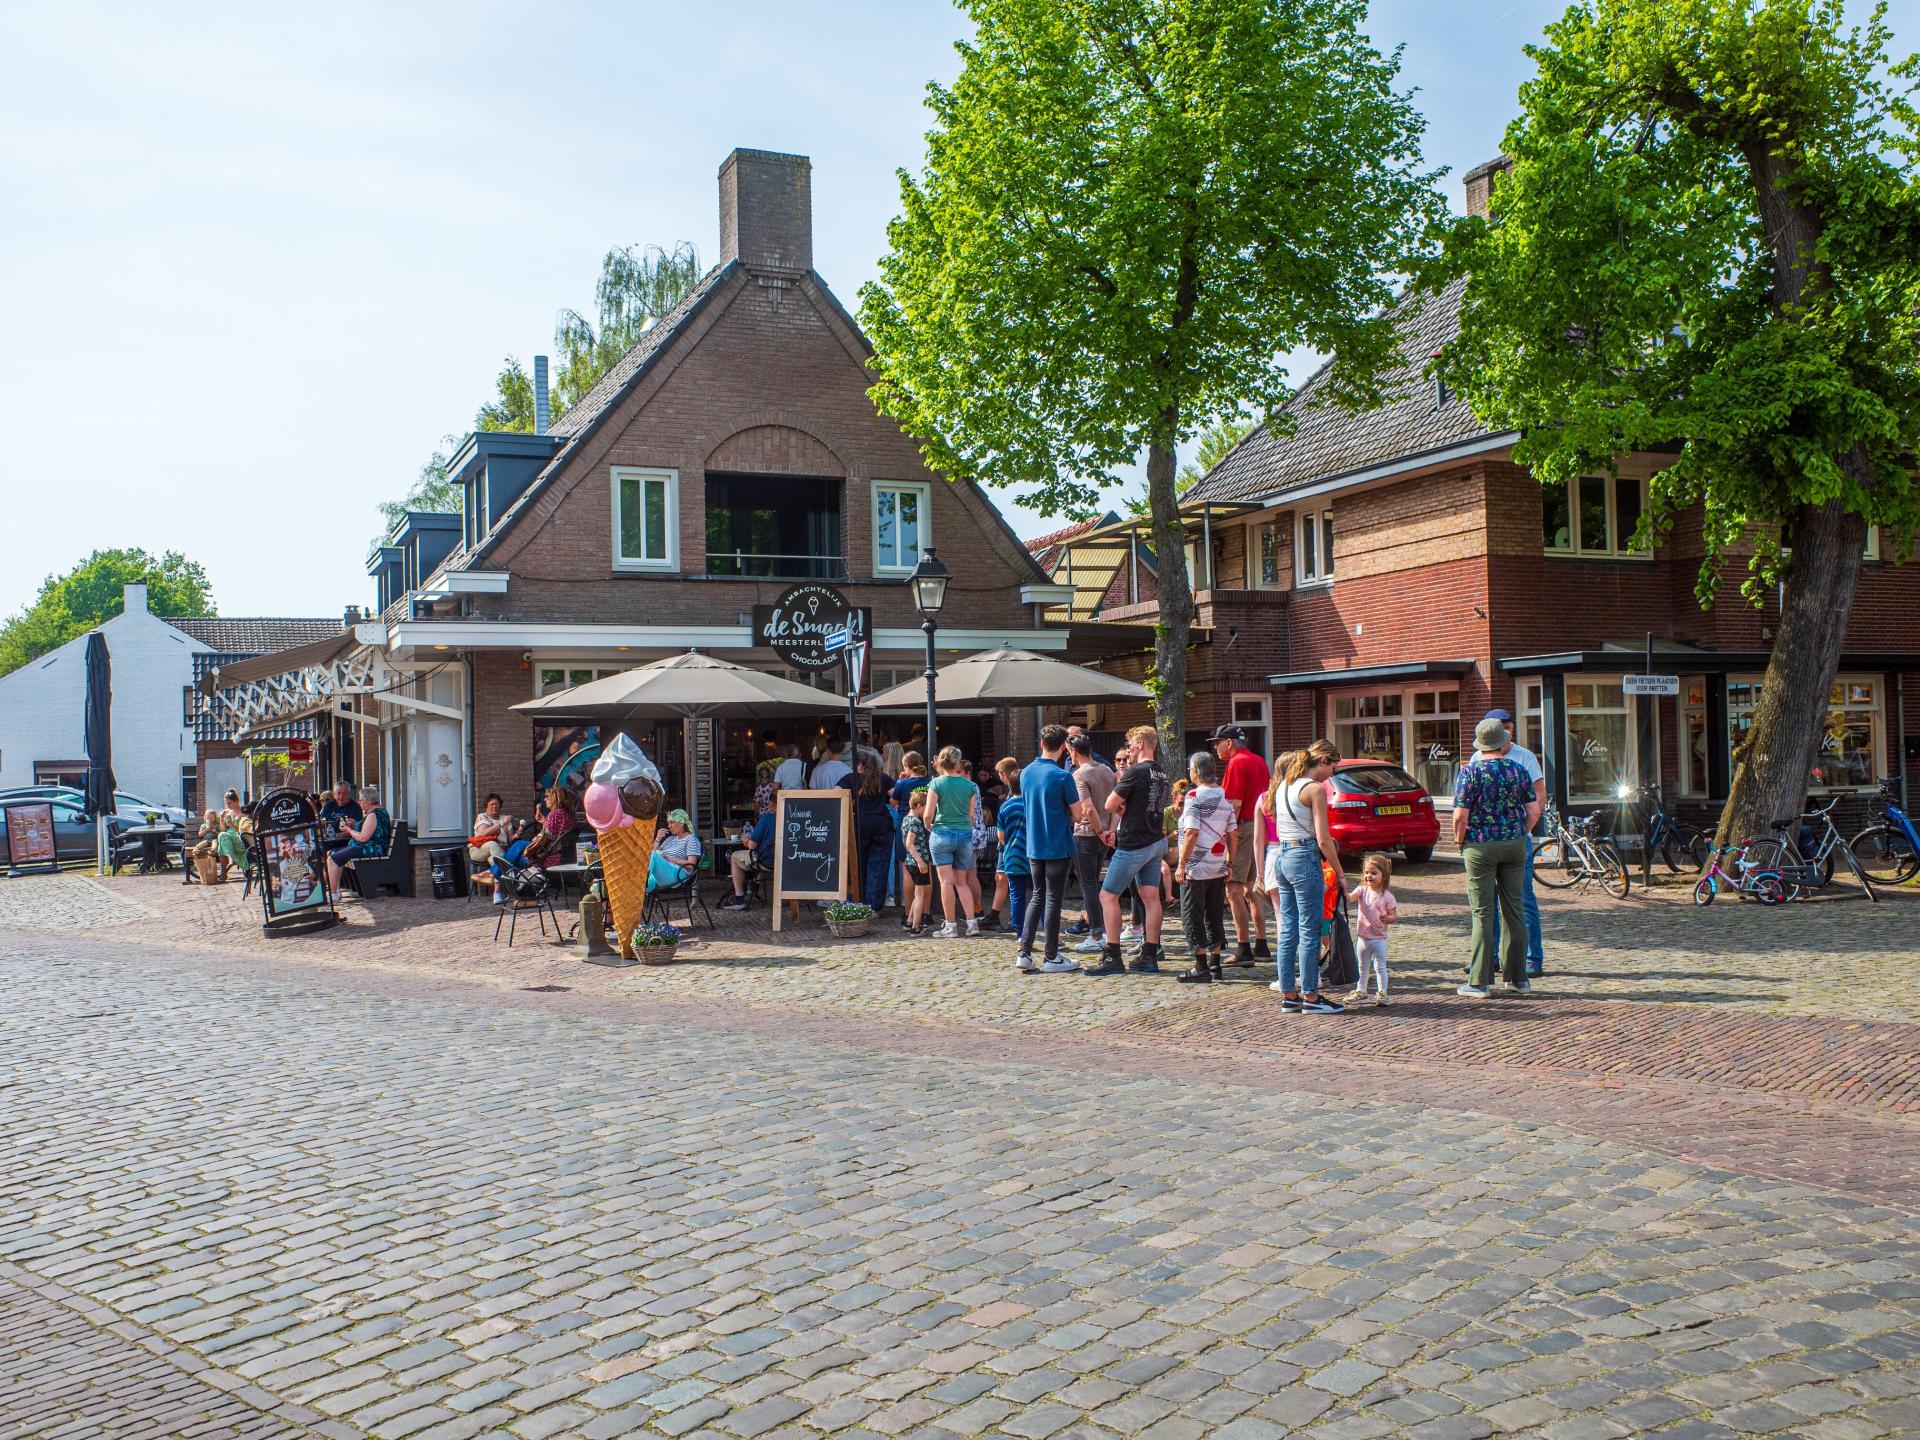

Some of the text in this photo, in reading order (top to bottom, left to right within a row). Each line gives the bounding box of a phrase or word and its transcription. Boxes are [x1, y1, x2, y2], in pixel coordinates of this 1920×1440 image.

[785, 586, 842, 607] AMBACHTELIJK
[763, 608, 790, 637] de
[791, 653, 838, 665] CHOCOLADE
